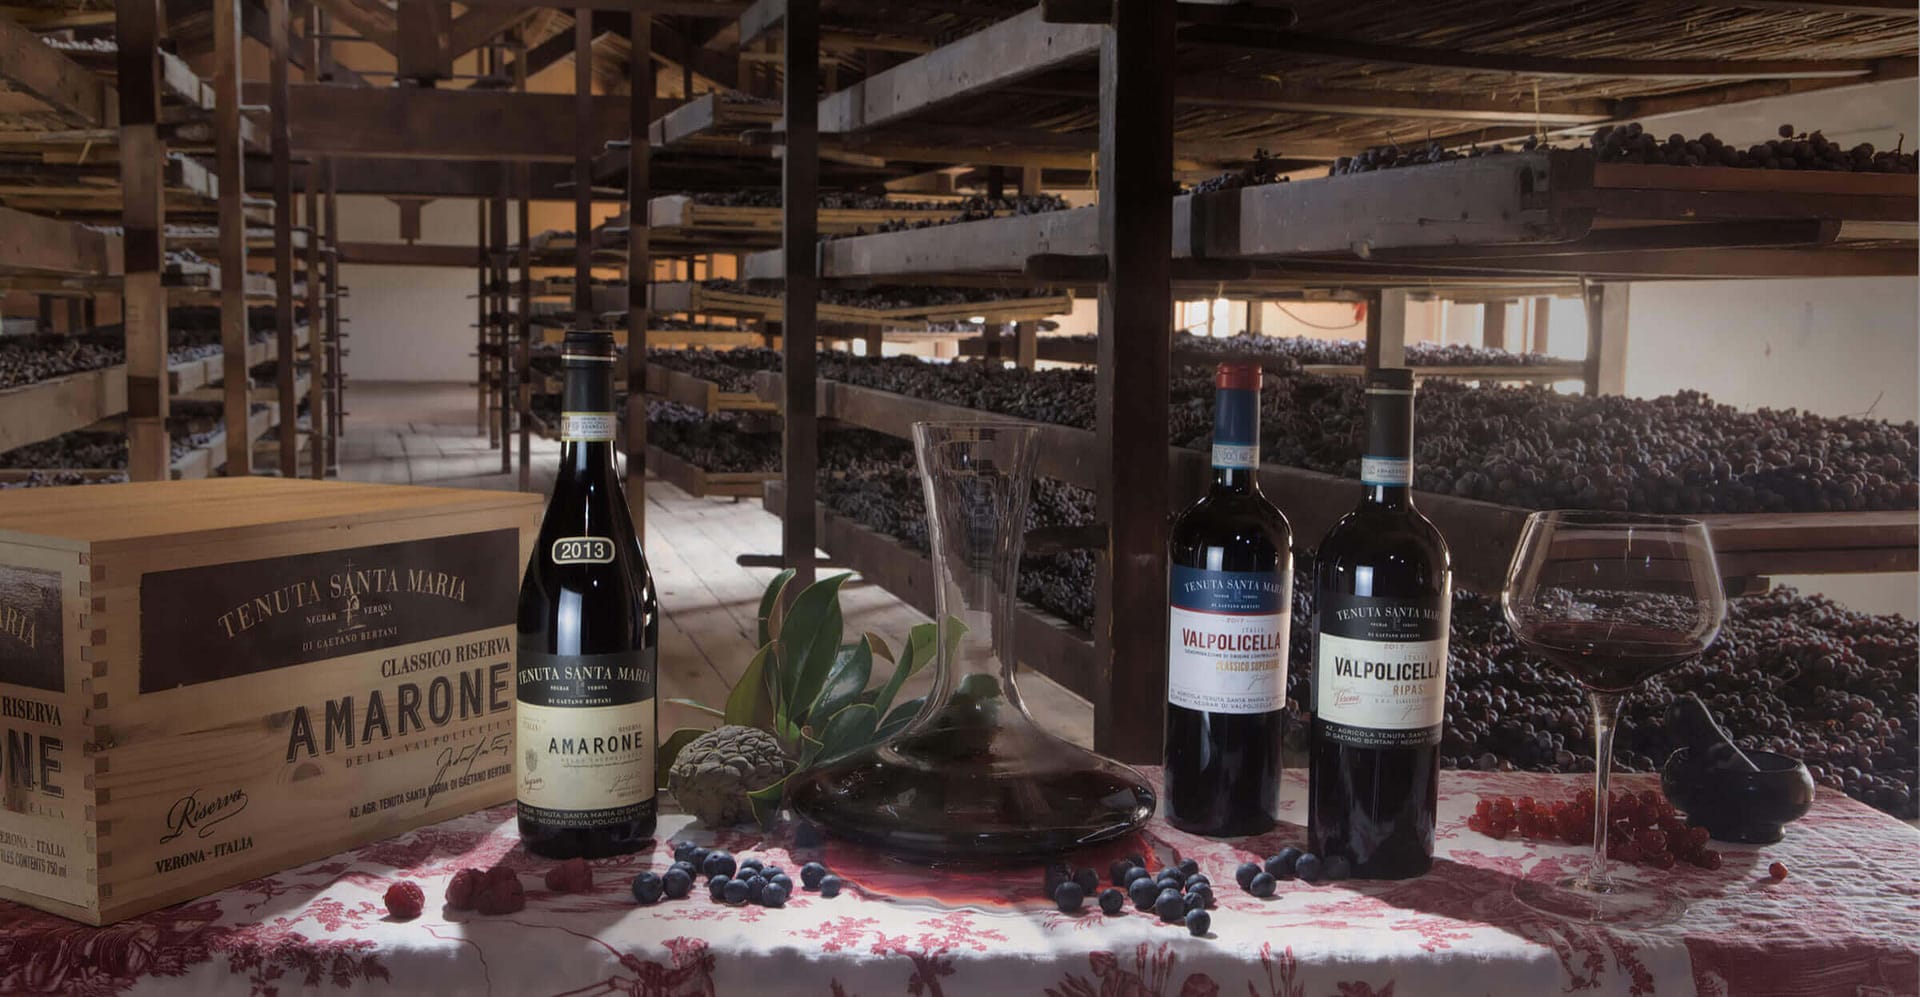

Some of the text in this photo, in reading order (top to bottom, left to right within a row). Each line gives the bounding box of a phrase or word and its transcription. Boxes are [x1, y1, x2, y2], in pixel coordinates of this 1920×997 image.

[561, 542, 604, 559] 2013
[1184, 579, 1283, 594] TENUTA SANTA MARI
[218, 569, 466, 639] TENUTA SANTA MARIA
[306, 603, 393, 624] NEGRAR VERONA
[1336, 607, 1381, 621] TENUTA
[1385, 606, 1420, 618] SANTA
[303, 626, 398, 651] DI GAETANO BERTANI
[1182, 627, 1281, 651] VALPOLICELLA
[381, 637, 511, 678] CLASSICO RISERVA
[1216, 659, 1281, 672] CLASSICO SUPERIORE
[1335, 656, 1441, 681] VALPOLICELLA
[518, 666, 651, 685] TENUTA SANTA MARIA
[2, 695, 62, 727] RISERVA
[285, 662, 512, 763] AMARONE
[548, 731, 643, 755] AMARONE
[1333, 733, 1361, 743] GAETANO
[1338, 727, 1374, 738] AGRICOLA
[0, 727, 64, 799] NE
[346, 749, 394, 769] DELLA
[350, 763, 512, 818] AZ. AGR. TENUTA SANTA MARIA DI GAETANO BERTANI
[161, 789, 248, 844] Riserva
[537, 809, 561, 819] TENUTA
[589, 810, 615, 819] MARIA
[579, 815, 633, 827] VALPOLICELLA
[37, 840, 66, 858] ITALIA
[155, 850, 205, 873] VERONA
[214, 836, 253, 858] ITALIA
[16, 852, 45, 873] CONTENTS
[46, 861, 57, 876] 750
